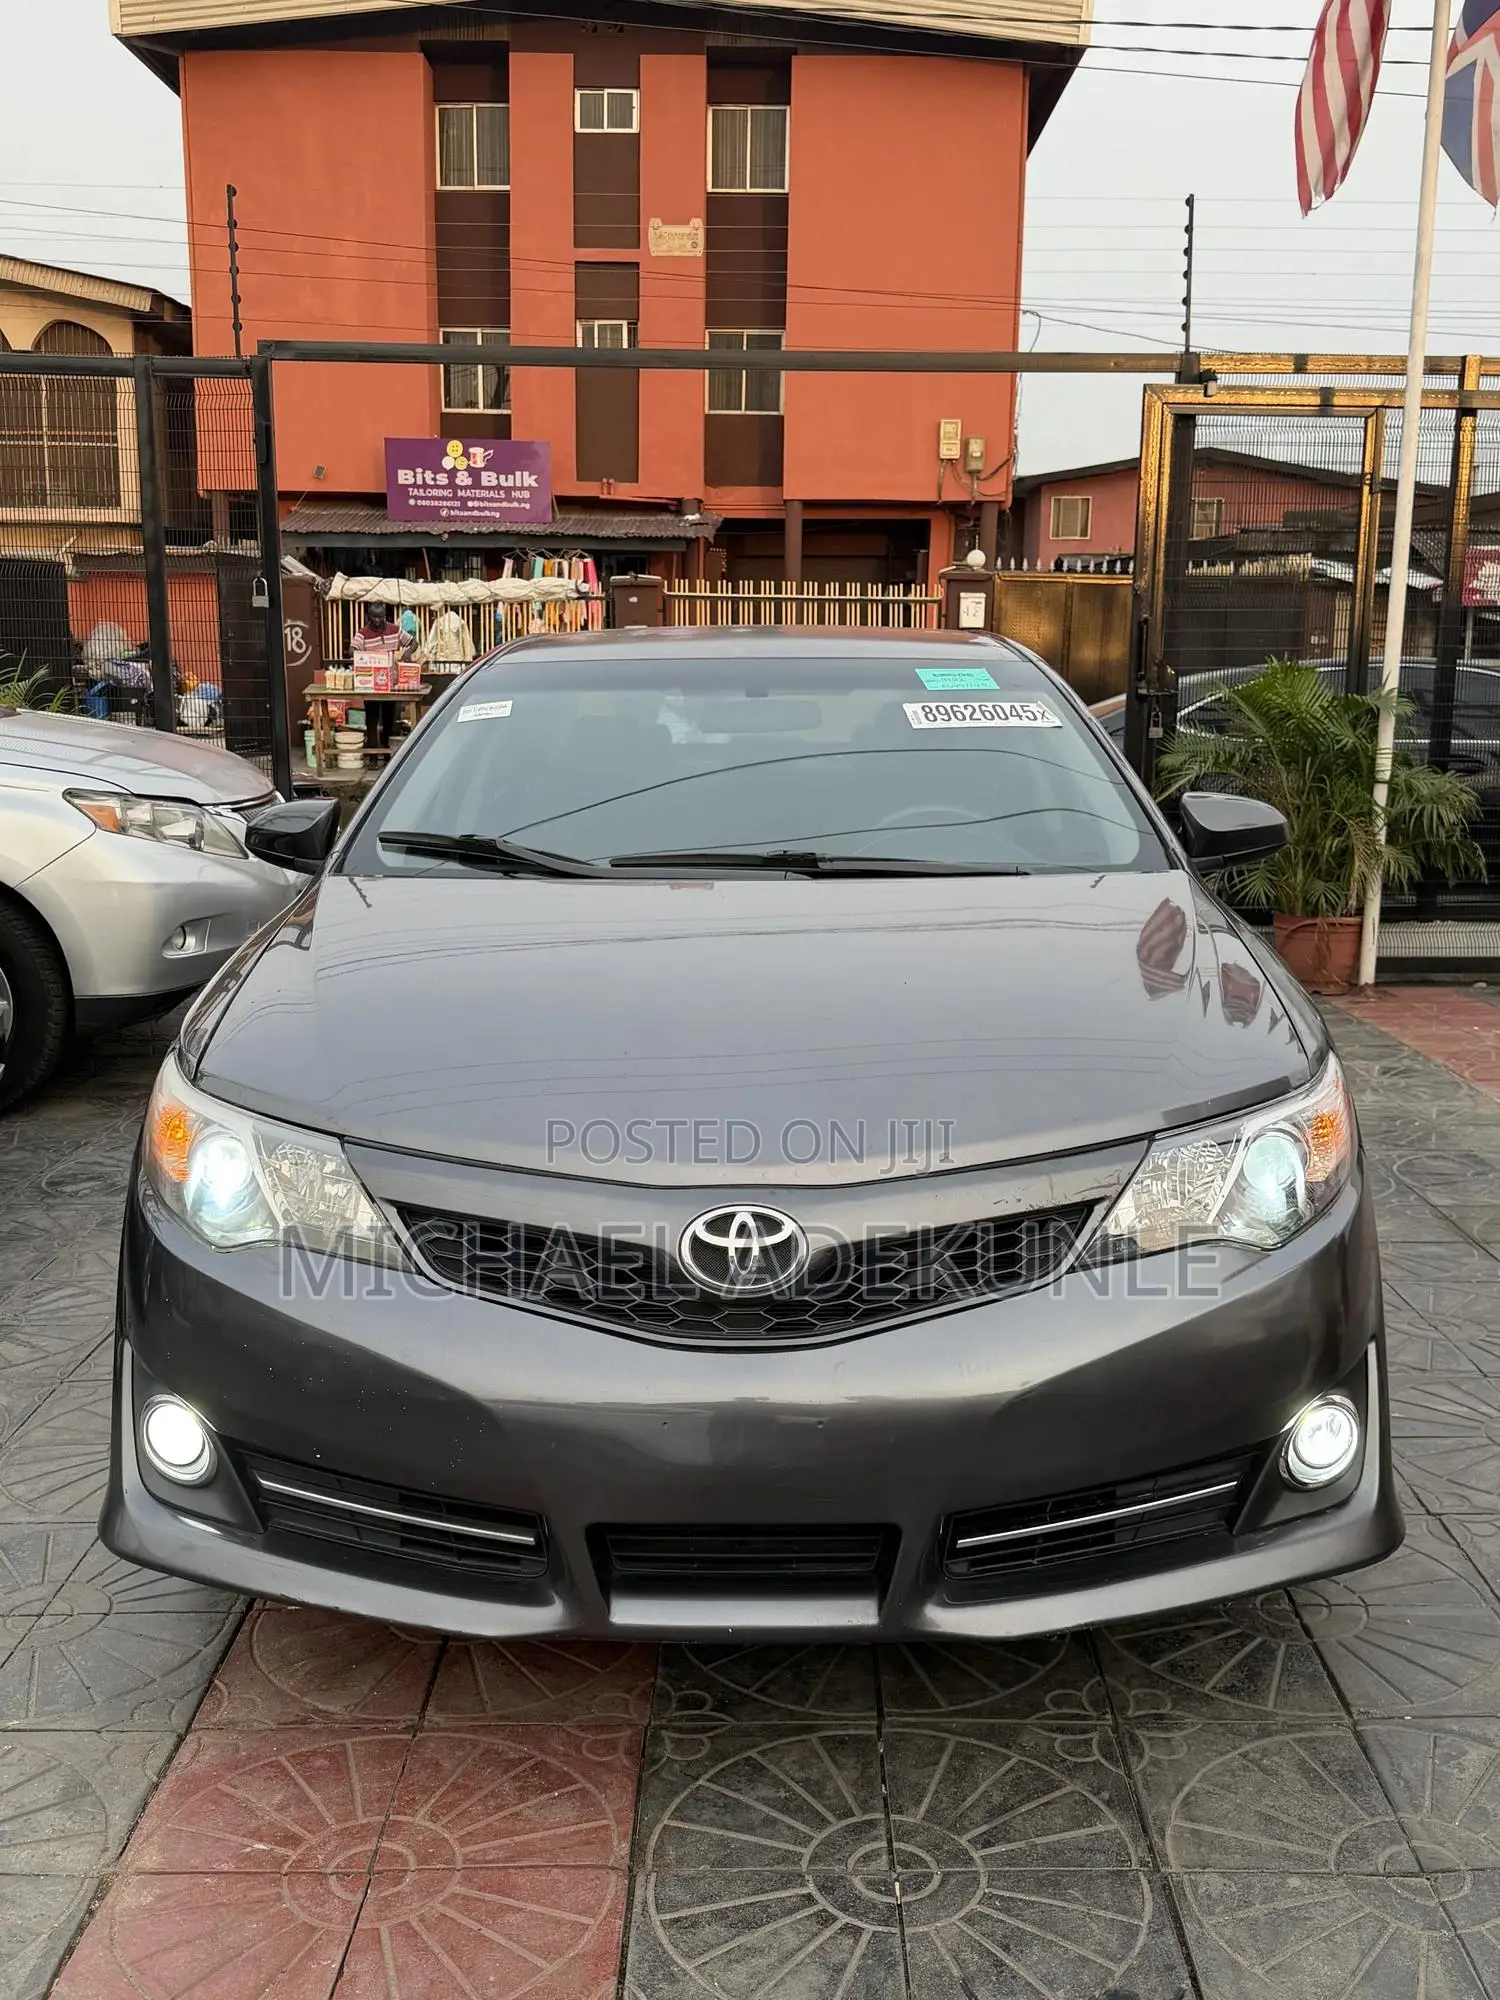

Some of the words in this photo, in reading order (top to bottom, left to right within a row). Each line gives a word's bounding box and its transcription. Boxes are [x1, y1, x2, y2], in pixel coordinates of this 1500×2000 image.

[397, 467, 449, 485] Bits
[455, 470, 473, 486] &
[480, 471, 539, 488] Bulk
[408, 487, 453, 498] TAILORING
[457, 488, 506, 498] MATERIALS
[511, 489, 530, 499] HUB
[284, 627, 306, 653] 18
[920, 704, 1038, 722] 89626045
